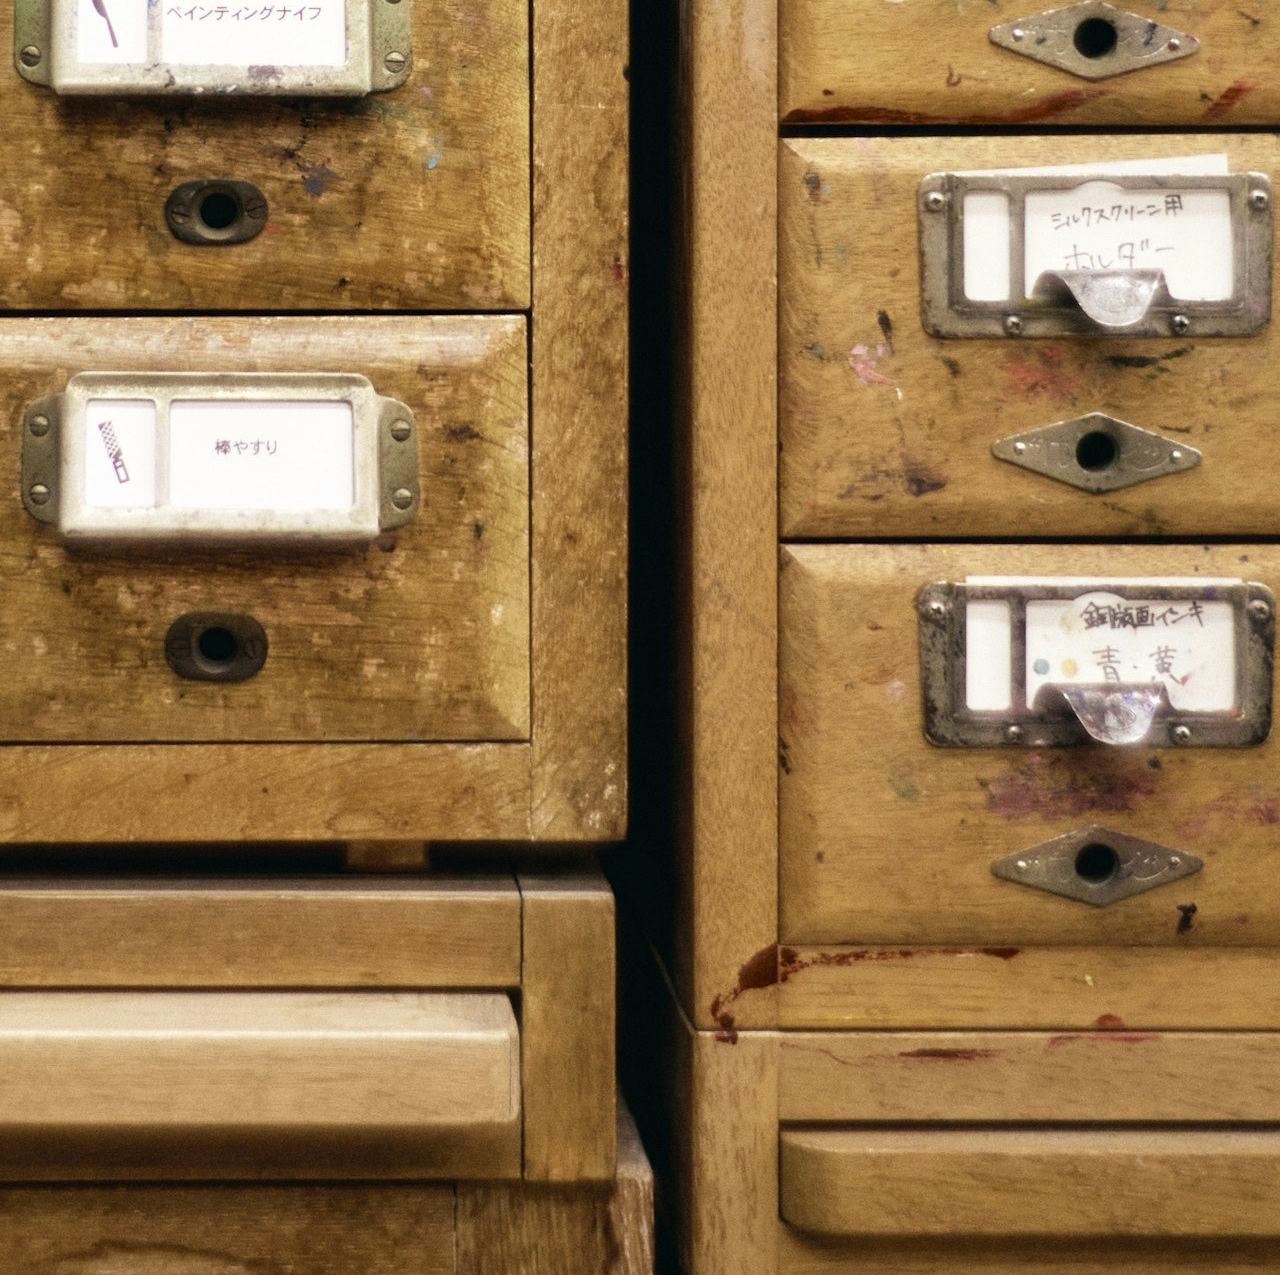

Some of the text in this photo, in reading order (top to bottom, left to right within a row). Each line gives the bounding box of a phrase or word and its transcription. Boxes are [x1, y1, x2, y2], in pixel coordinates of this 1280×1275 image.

[166, 4, 323, 22] ペインティングナイフ
[1050, 193, 1184, 230] シルクスクリーン用
[1063, 238, 1176, 269] ホルダー
[213, 438, 279, 456] 棒やすり
